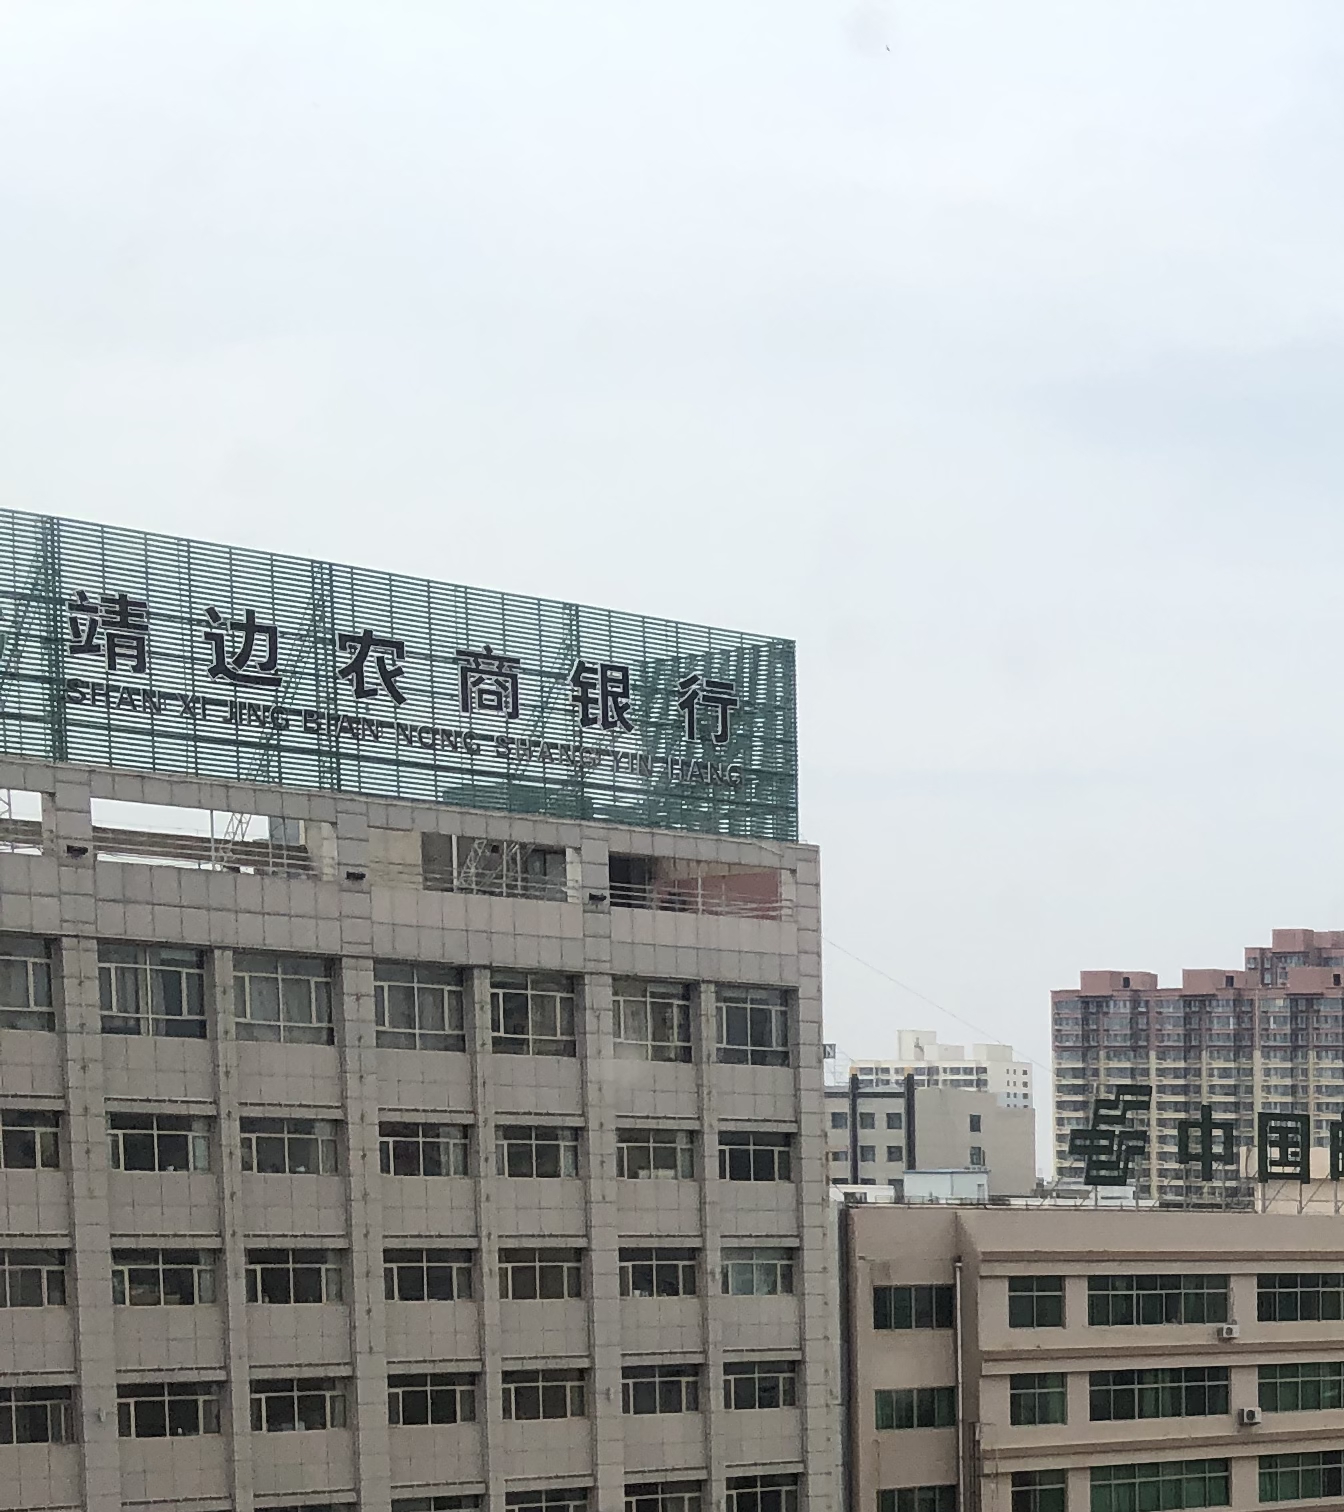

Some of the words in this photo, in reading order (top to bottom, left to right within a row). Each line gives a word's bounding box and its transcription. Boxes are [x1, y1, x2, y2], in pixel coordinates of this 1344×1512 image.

[64, 678, 163, 716] SHAN
[176, 693, 207, 720] XI
[223, 700, 290, 731] JING
[301, 709, 385, 742] BIAN
[394, 722, 482, 756] NONG
[496, 736, 600, 769] SHANG
[609, 750, 655, 777] YIN
[668, 758, 745, 787] HANG
[65, 589, 739, 745] 靖边农商银行
